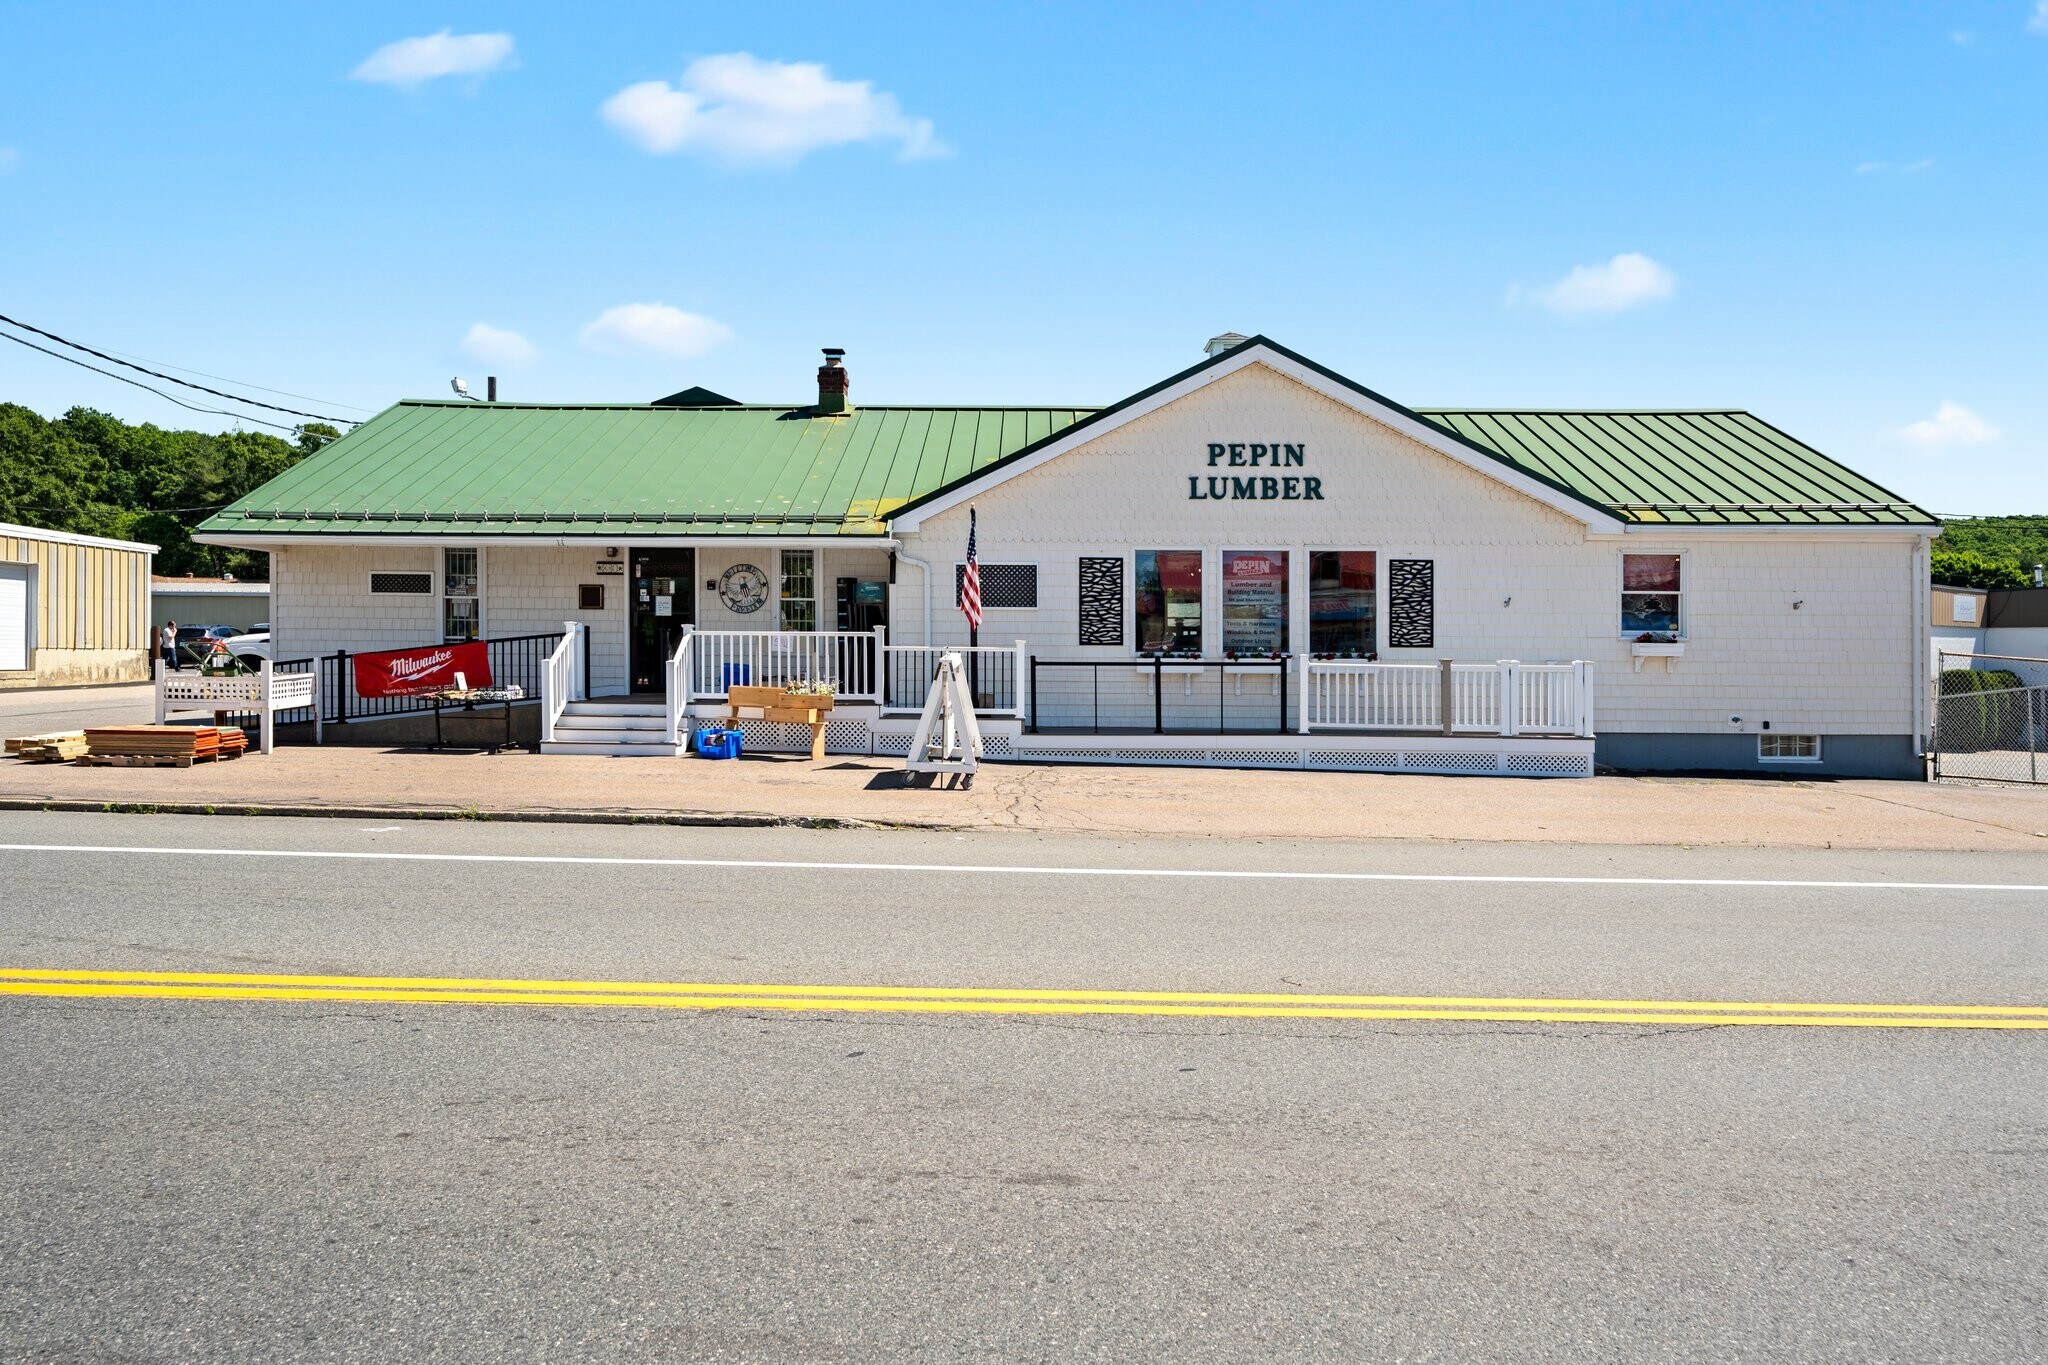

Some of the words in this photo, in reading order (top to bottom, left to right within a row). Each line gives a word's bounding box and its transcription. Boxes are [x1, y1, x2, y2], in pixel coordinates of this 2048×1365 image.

[1207, 443, 1305, 467] PEPIN
[1188, 476, 1325, 500] LUMBER
[723, 564, 759, 581] WELCOME
[1233, 560, 1270, 574] PEPIN
[388, 650, 452, 677] Milwaukee
[382, 687, 407, 695] Nothing
